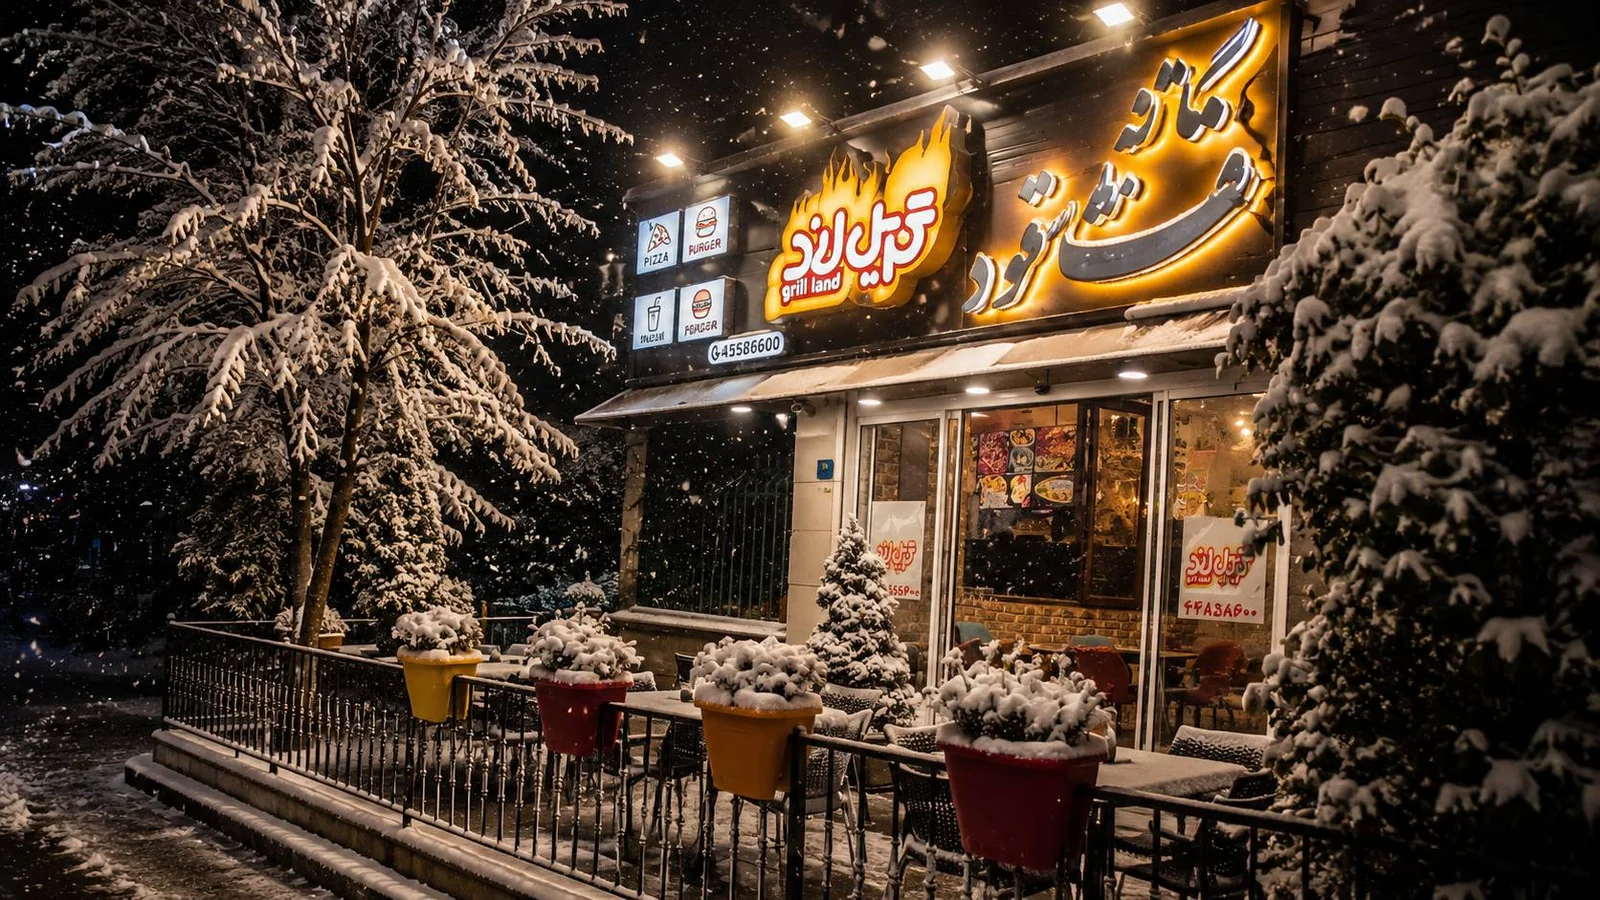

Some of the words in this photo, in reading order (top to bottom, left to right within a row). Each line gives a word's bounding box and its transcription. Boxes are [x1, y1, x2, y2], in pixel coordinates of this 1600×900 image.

[644, 252, 669, 267] PIZZA
[783, 210, 846, 281] لند
[845, 190, 936, 287] گریل
[781, 276, 808, 303] grill
[811, 271, 842, 294] land
